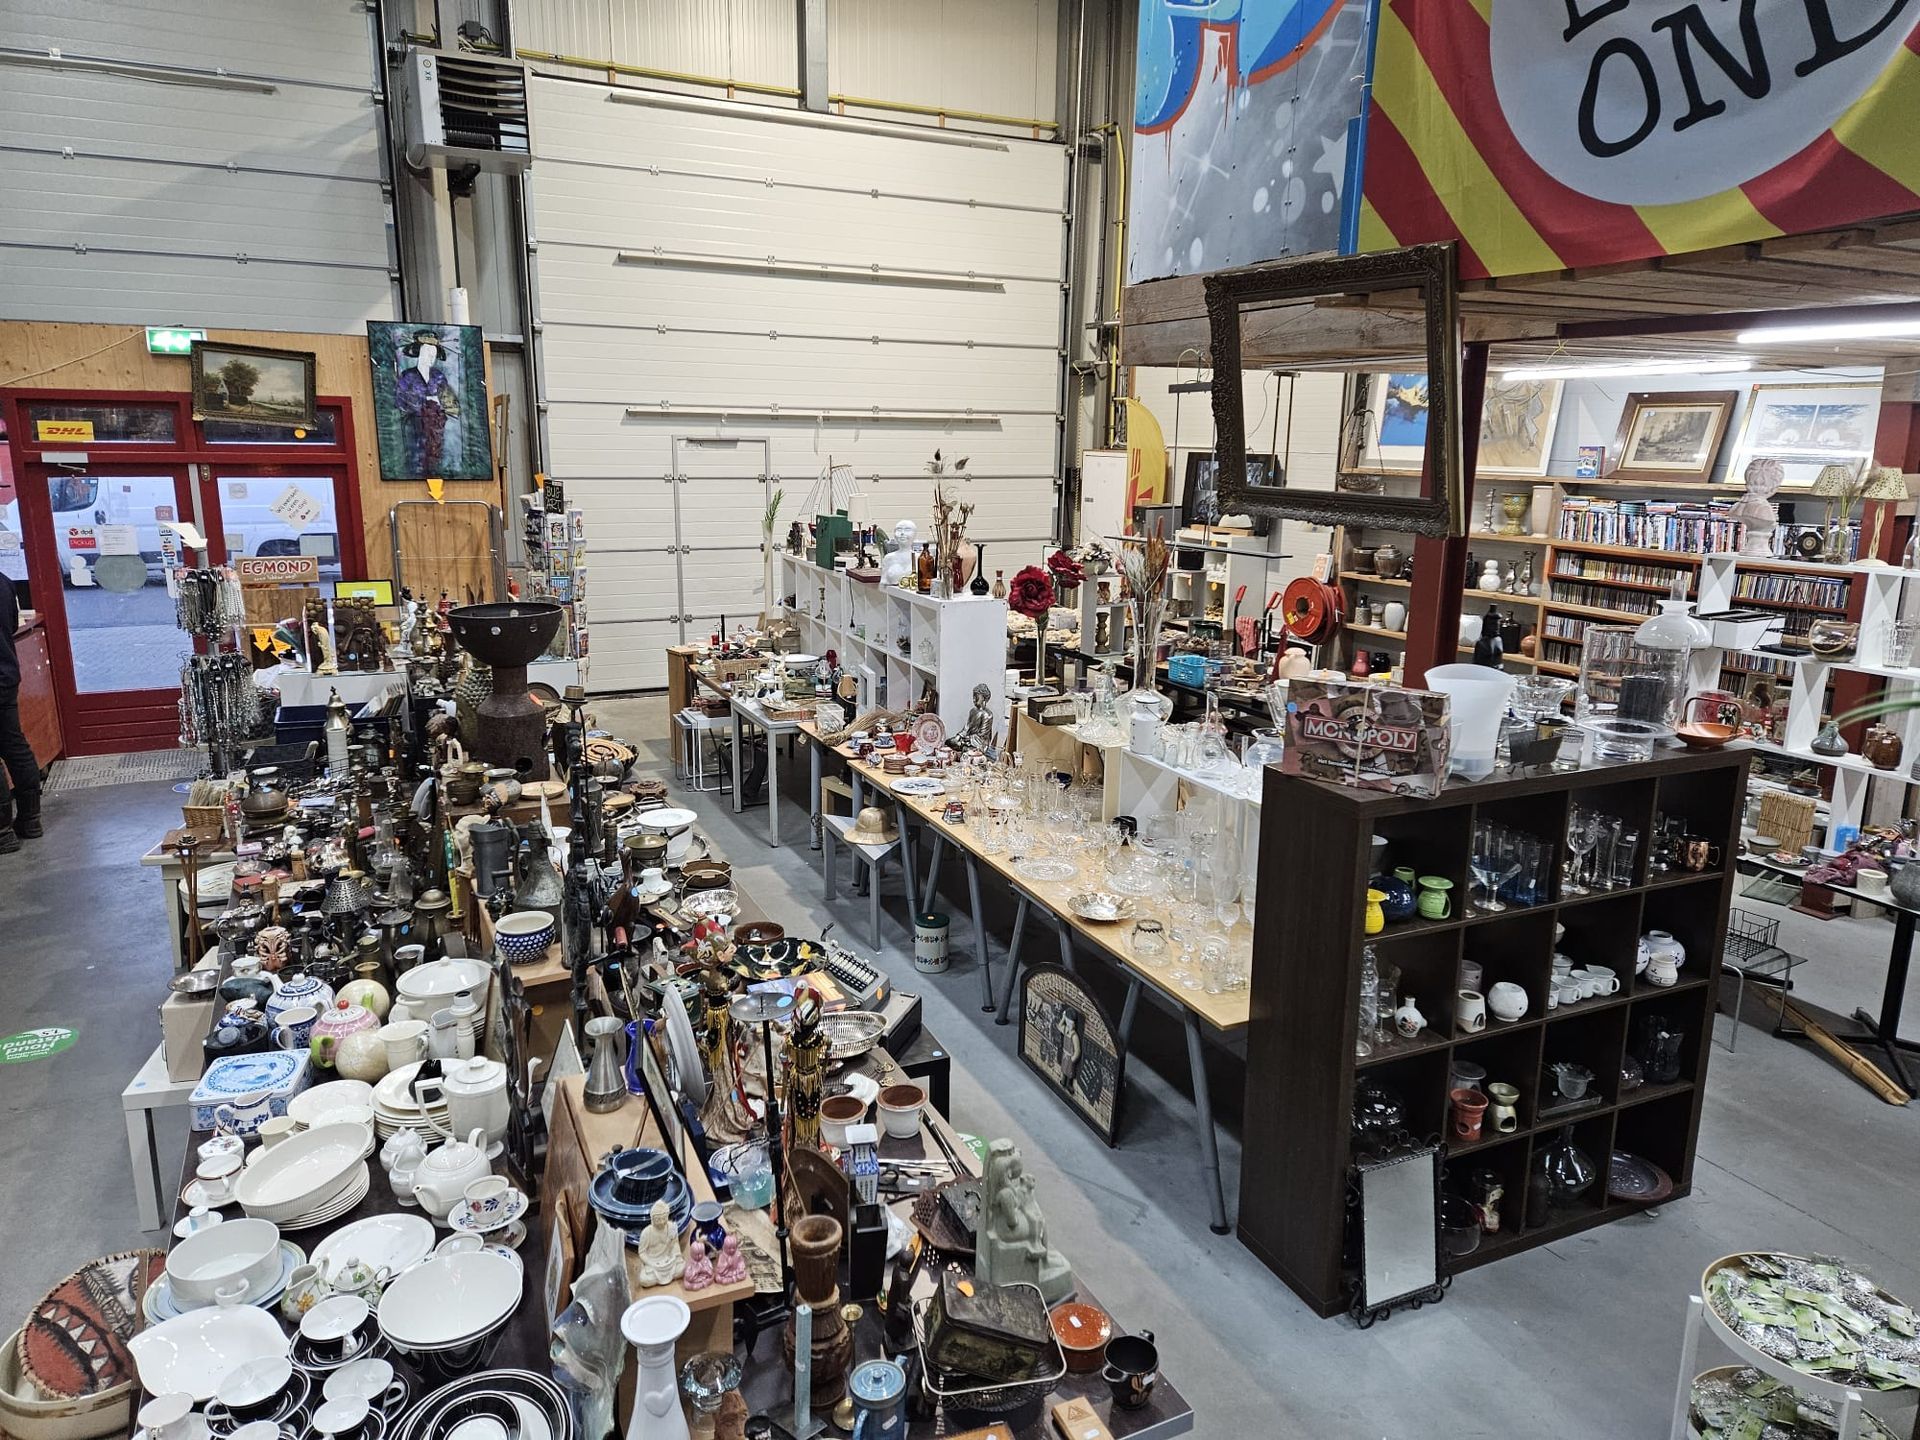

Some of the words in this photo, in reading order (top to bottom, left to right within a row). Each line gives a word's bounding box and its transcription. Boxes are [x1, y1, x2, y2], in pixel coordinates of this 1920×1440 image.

[46, 427, 86, 435] DHL
[80, 528, 93, 536] dpd
[241, 560, 312, 575] EGMOND
